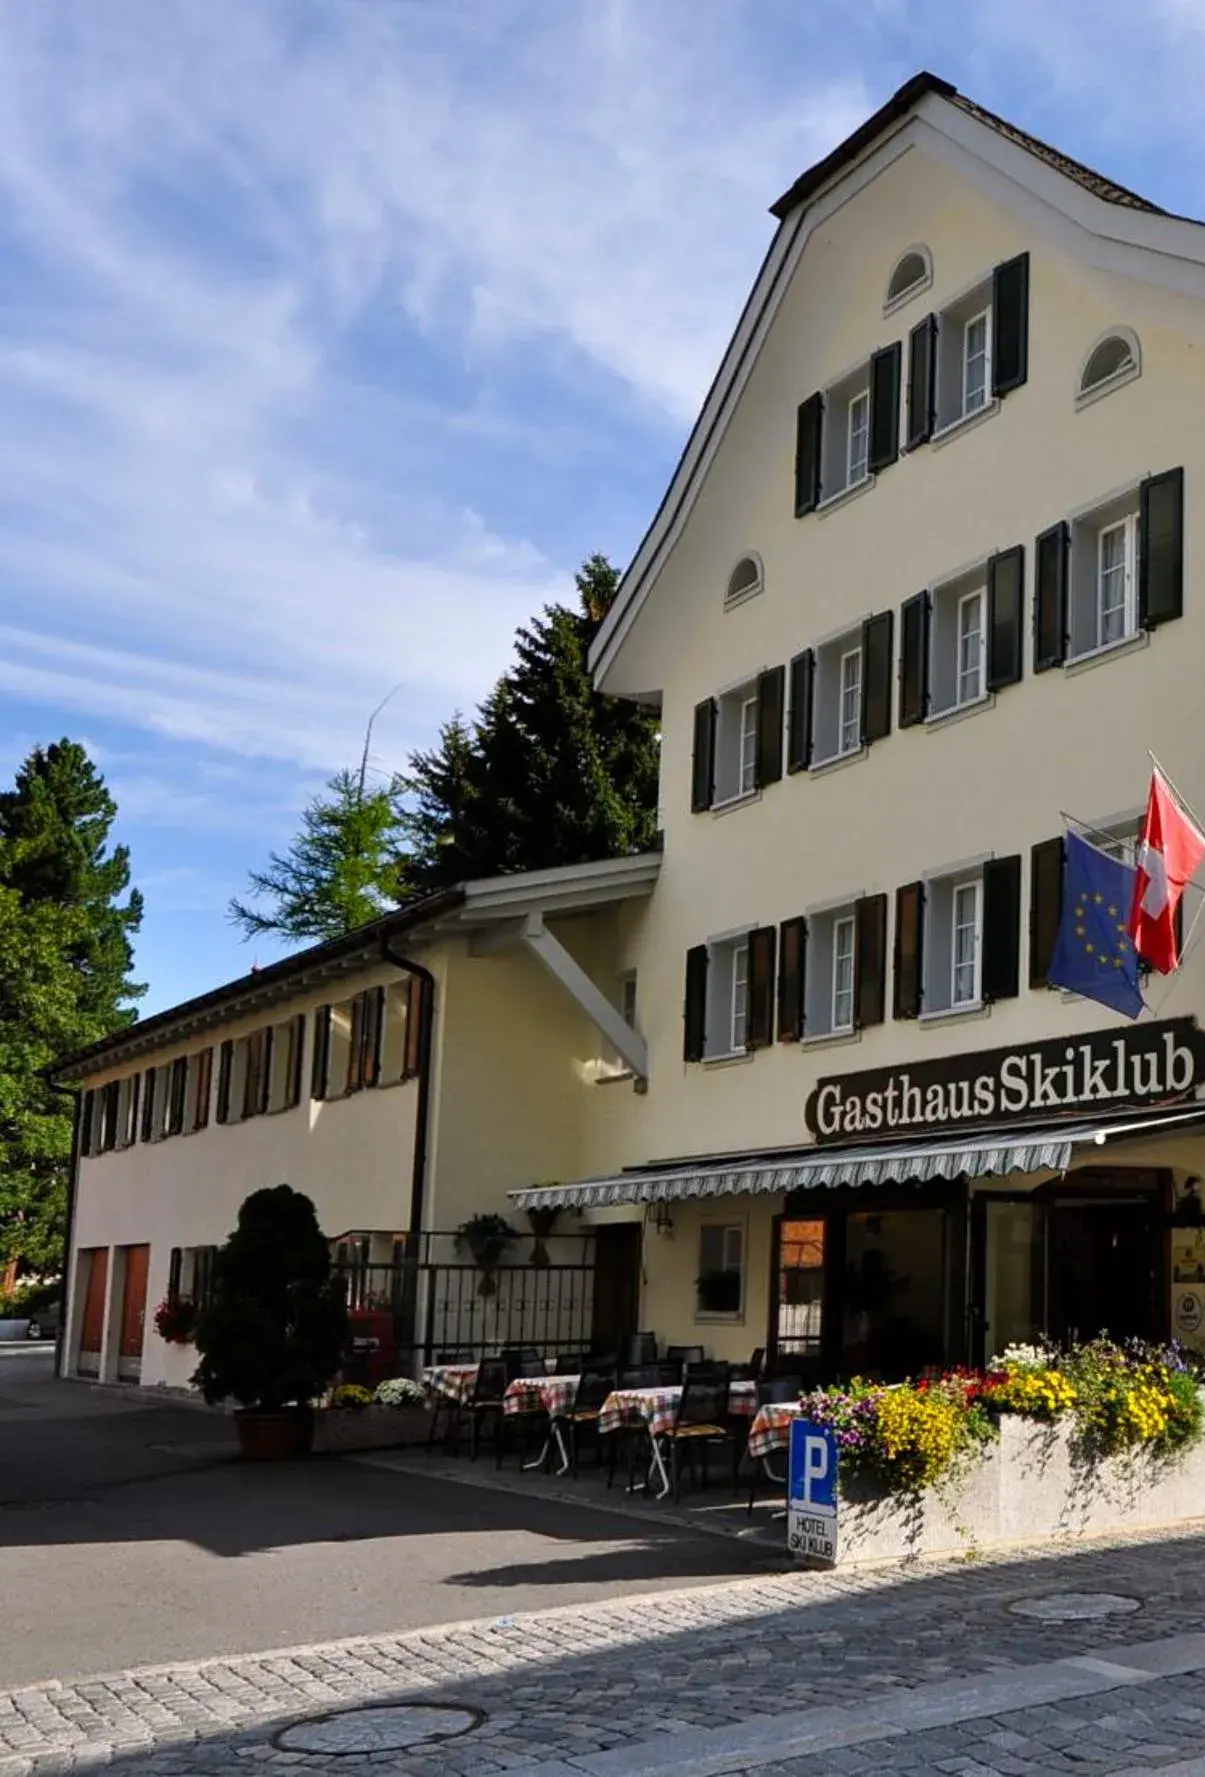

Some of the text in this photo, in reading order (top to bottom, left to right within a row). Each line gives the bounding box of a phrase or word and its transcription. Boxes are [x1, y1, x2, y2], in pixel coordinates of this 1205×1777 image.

[815, 1032, 1195, 1136] Gasthaus Skiklub
[804, 1436, 828, 1503] P
[796, 1516, 828, 1538] HOTEL
